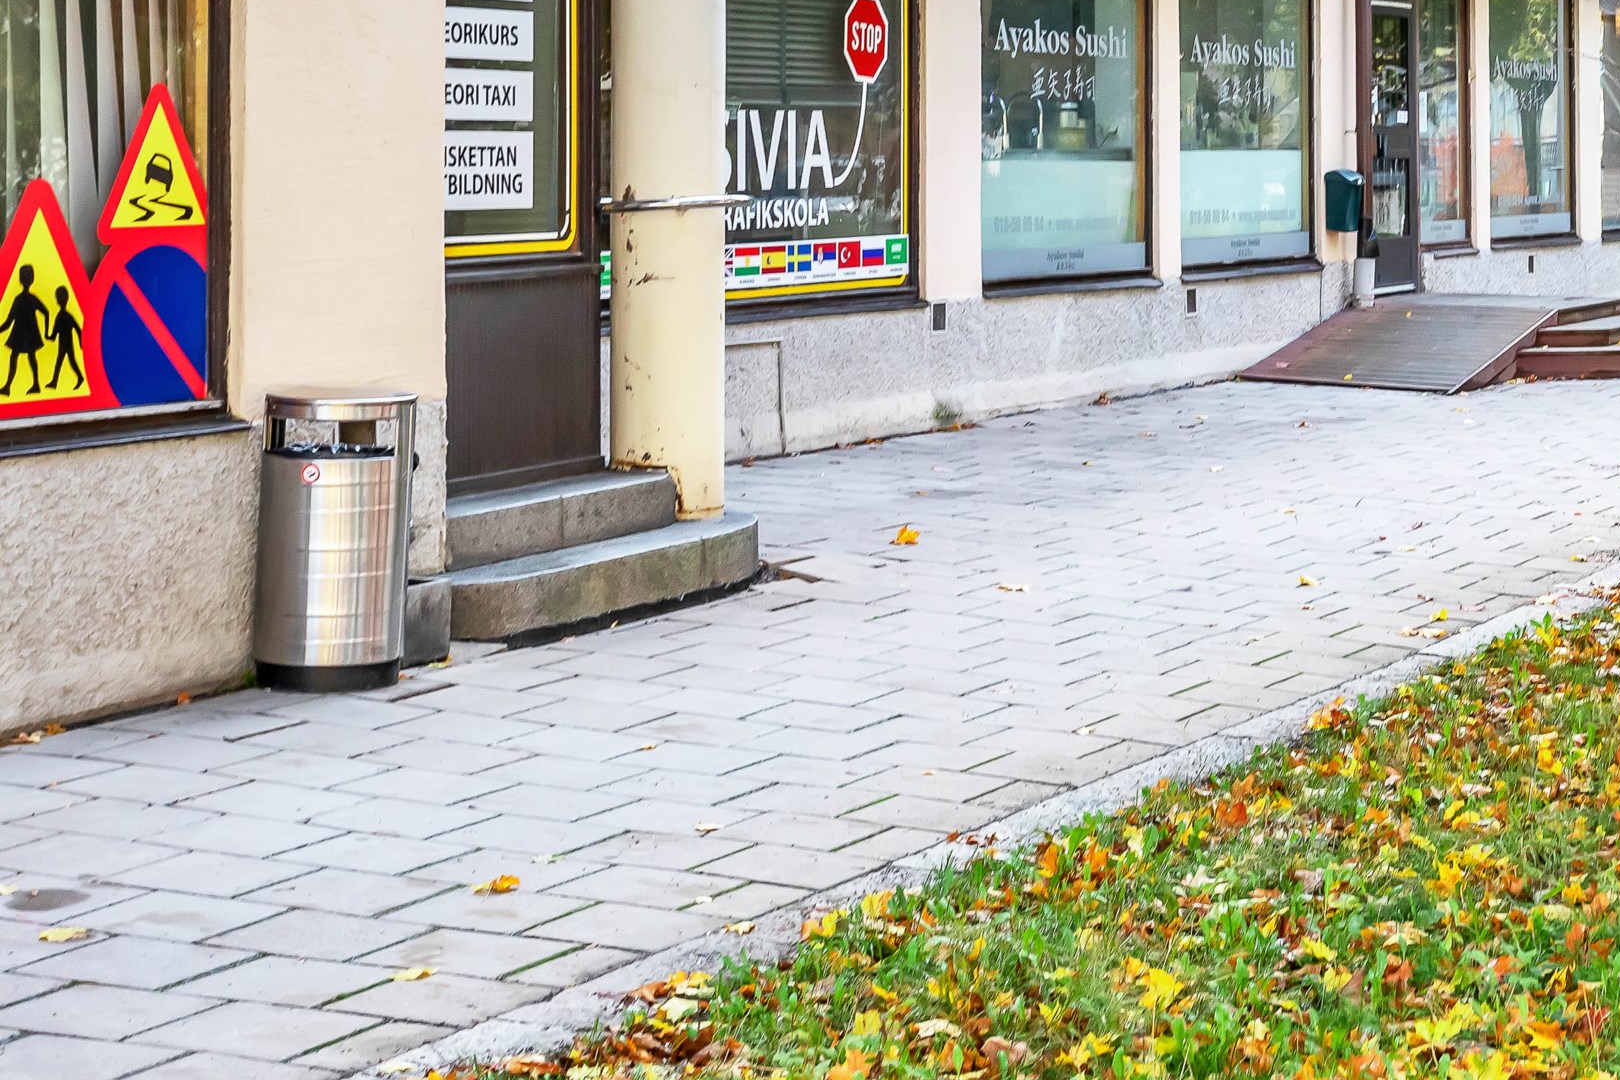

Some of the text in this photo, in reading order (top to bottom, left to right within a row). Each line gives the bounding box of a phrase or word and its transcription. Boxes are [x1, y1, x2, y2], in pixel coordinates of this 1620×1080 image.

[851, 21, 882, 54] STOP
[994, 18, 1128, 60] Ayakos Sushi
[1190, 33, 1296, 71] Ayakos Sushi
[1494, 54, 1531, 81] Ayakos
[445, 83, 516, 107] EORI TAXI
[444, 173, 523, 196] BILDNING
